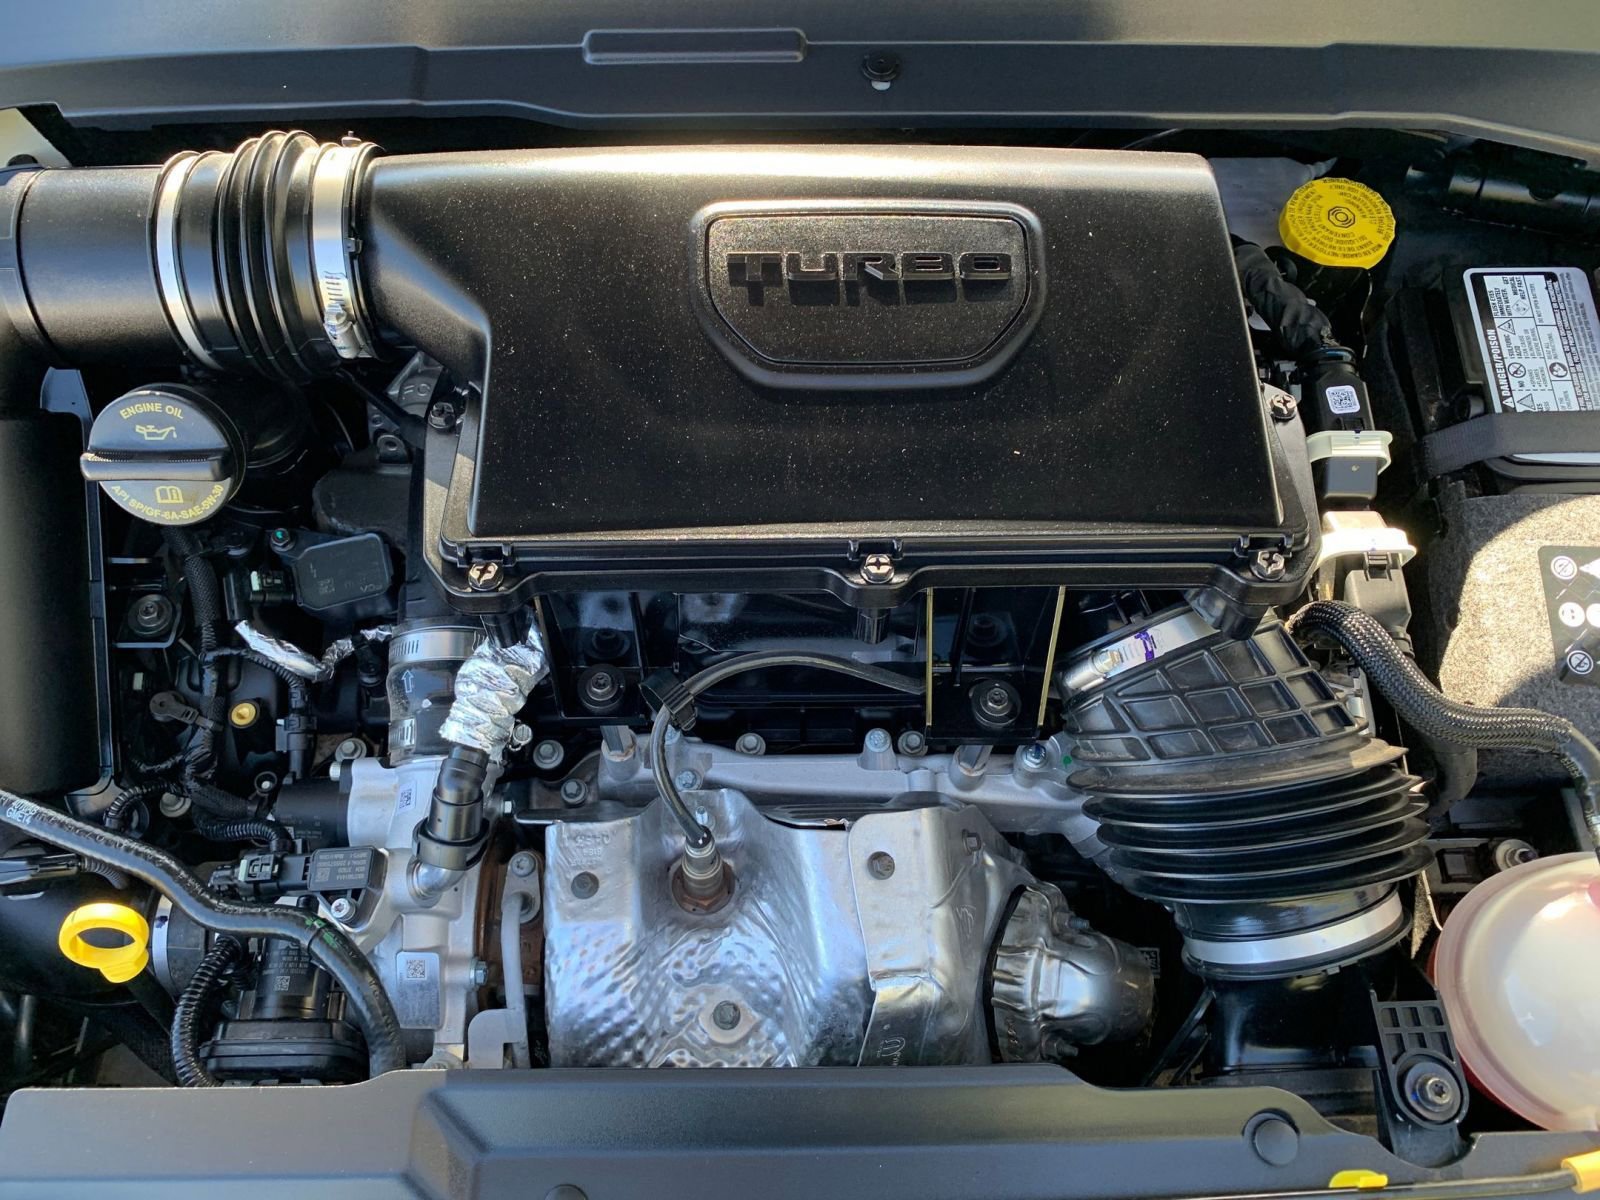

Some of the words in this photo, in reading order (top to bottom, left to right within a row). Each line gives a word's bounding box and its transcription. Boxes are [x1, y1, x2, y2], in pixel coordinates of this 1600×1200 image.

[727, 252, 1012, 281] TURBO
[1487, 329, 1510, 396] DANGER/POISON
[119, 402, 163, 420] ENGINE
[165, 405, 184, 419] OIL
[110, 485, 129, 501] API
